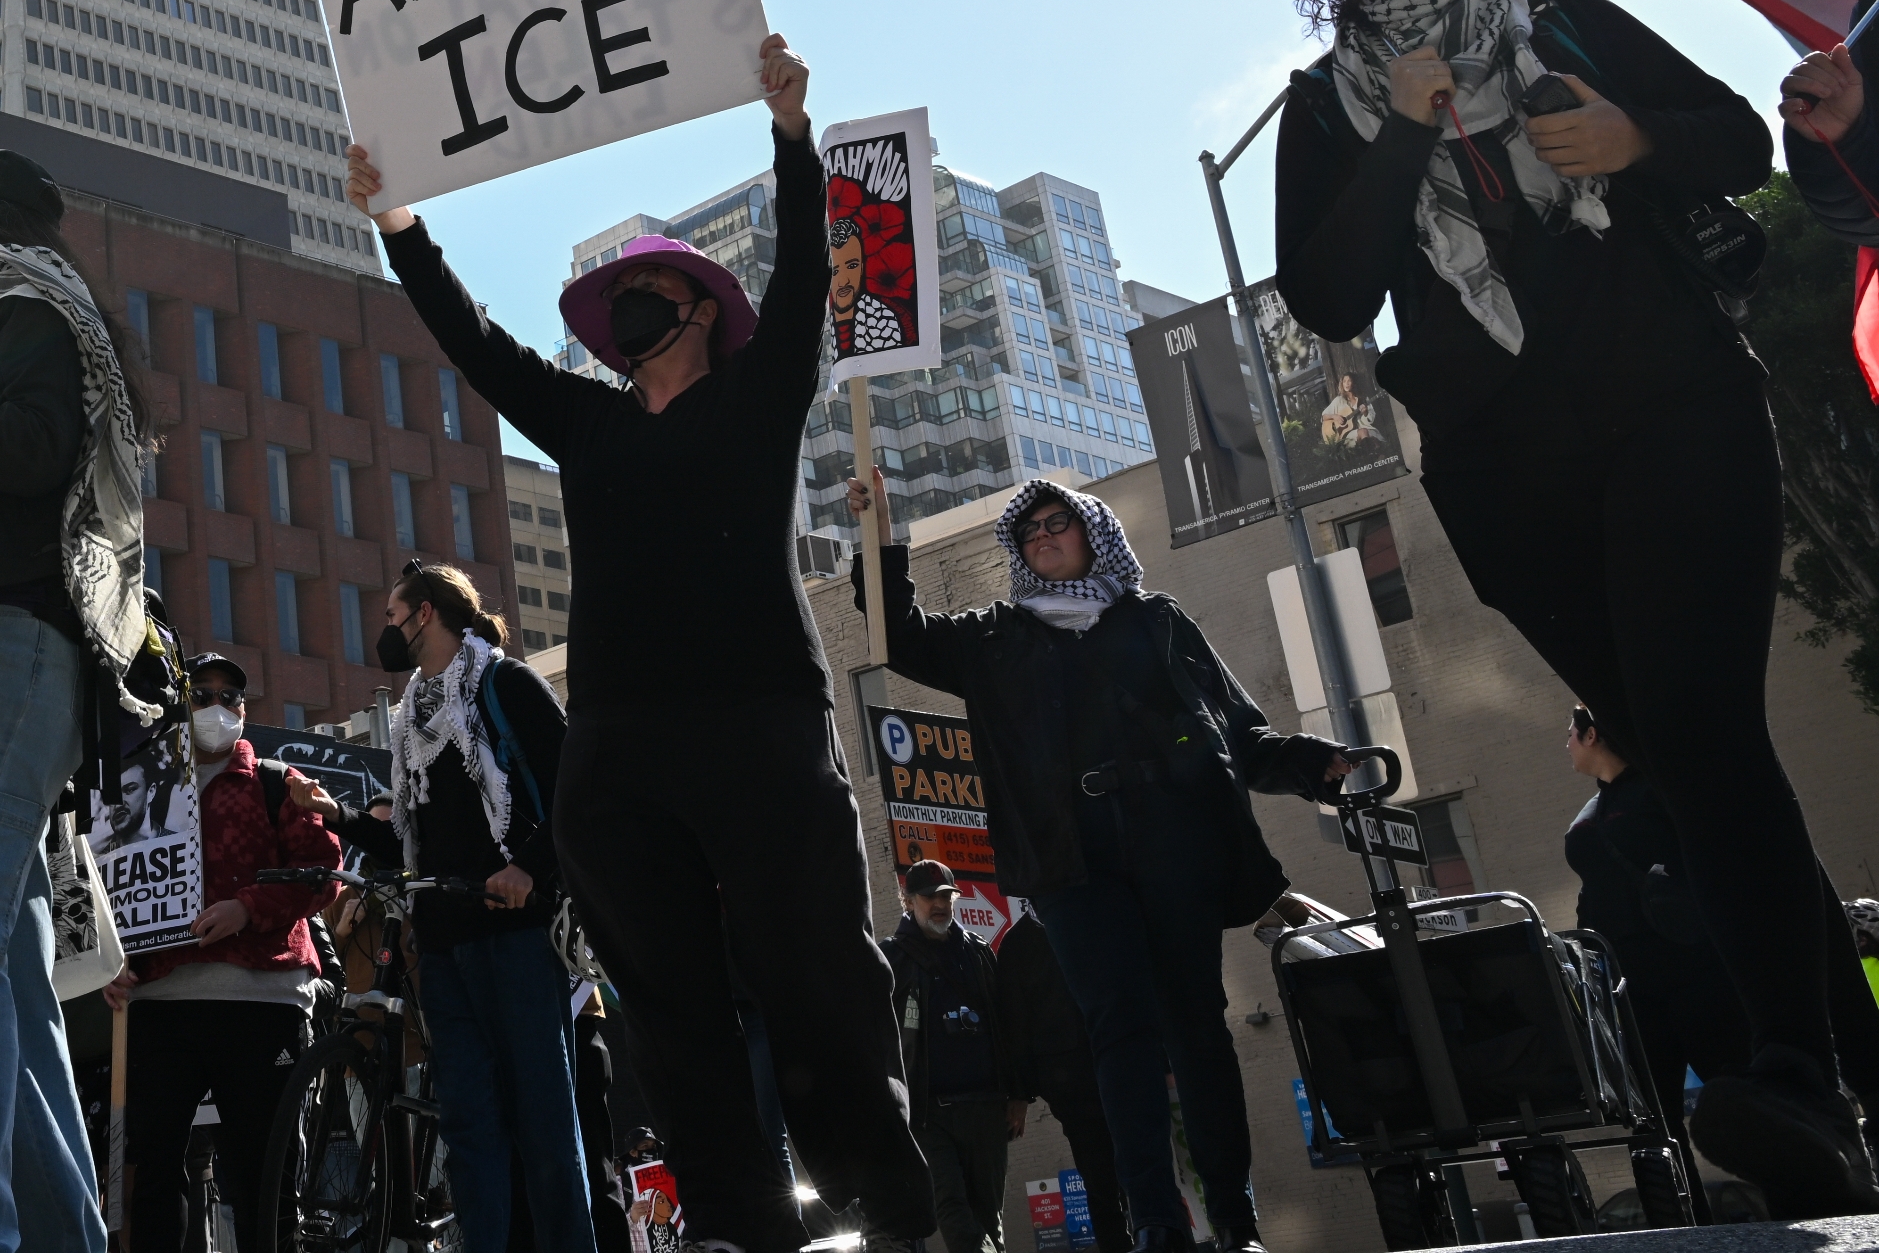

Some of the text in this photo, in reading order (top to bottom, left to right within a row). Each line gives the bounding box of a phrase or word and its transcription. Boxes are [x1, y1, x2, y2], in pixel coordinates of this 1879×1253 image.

[1696, 221, 1723, 242] PYLE
[1703, 233, 1746, 261] MP53IN
[1164, 322, 1198, 357] ICON
[1297, 455, 1399, 493] TRANSAMERICA PYRAMID CENTER
[1175, 514, 1219, 534] TRANSAMERICA
[1219, 505, 1246, 520] PYRAMID
[1246, 498, 1270, 510] CENTER
[915, 723, 974, 761] PUB
[891, 765, 986, 808] PARKI
[893, 804, 938, 823] MONTHLY
[940, 810, 983, 828] PARKING
[898, 824, 938, 842] CALL:
[942, 831, 970, 847] (415)
[1365, 819, 1414, 848] ON WAY
[98, 842, 187, 896] LEASE
[945, 850, 994, 865] 635 SANS
[110, 880, 188, 909] MOUD
[1418, 889, 1432, 900] 400
[113, 897, 188, 929] ALIL!
[959, 907, 995, 927] HERE
[1419, 914, 1458, 927] ackson
[138, 936, 155, 947] and
[157, 929, 196, 943] Liberatio
[1068, 1174, 1083, 1182] SPO
[1034, 1204, 1060, 1213] JACKSON
[1066, 1206, 1089, 1215] ACCEPT
